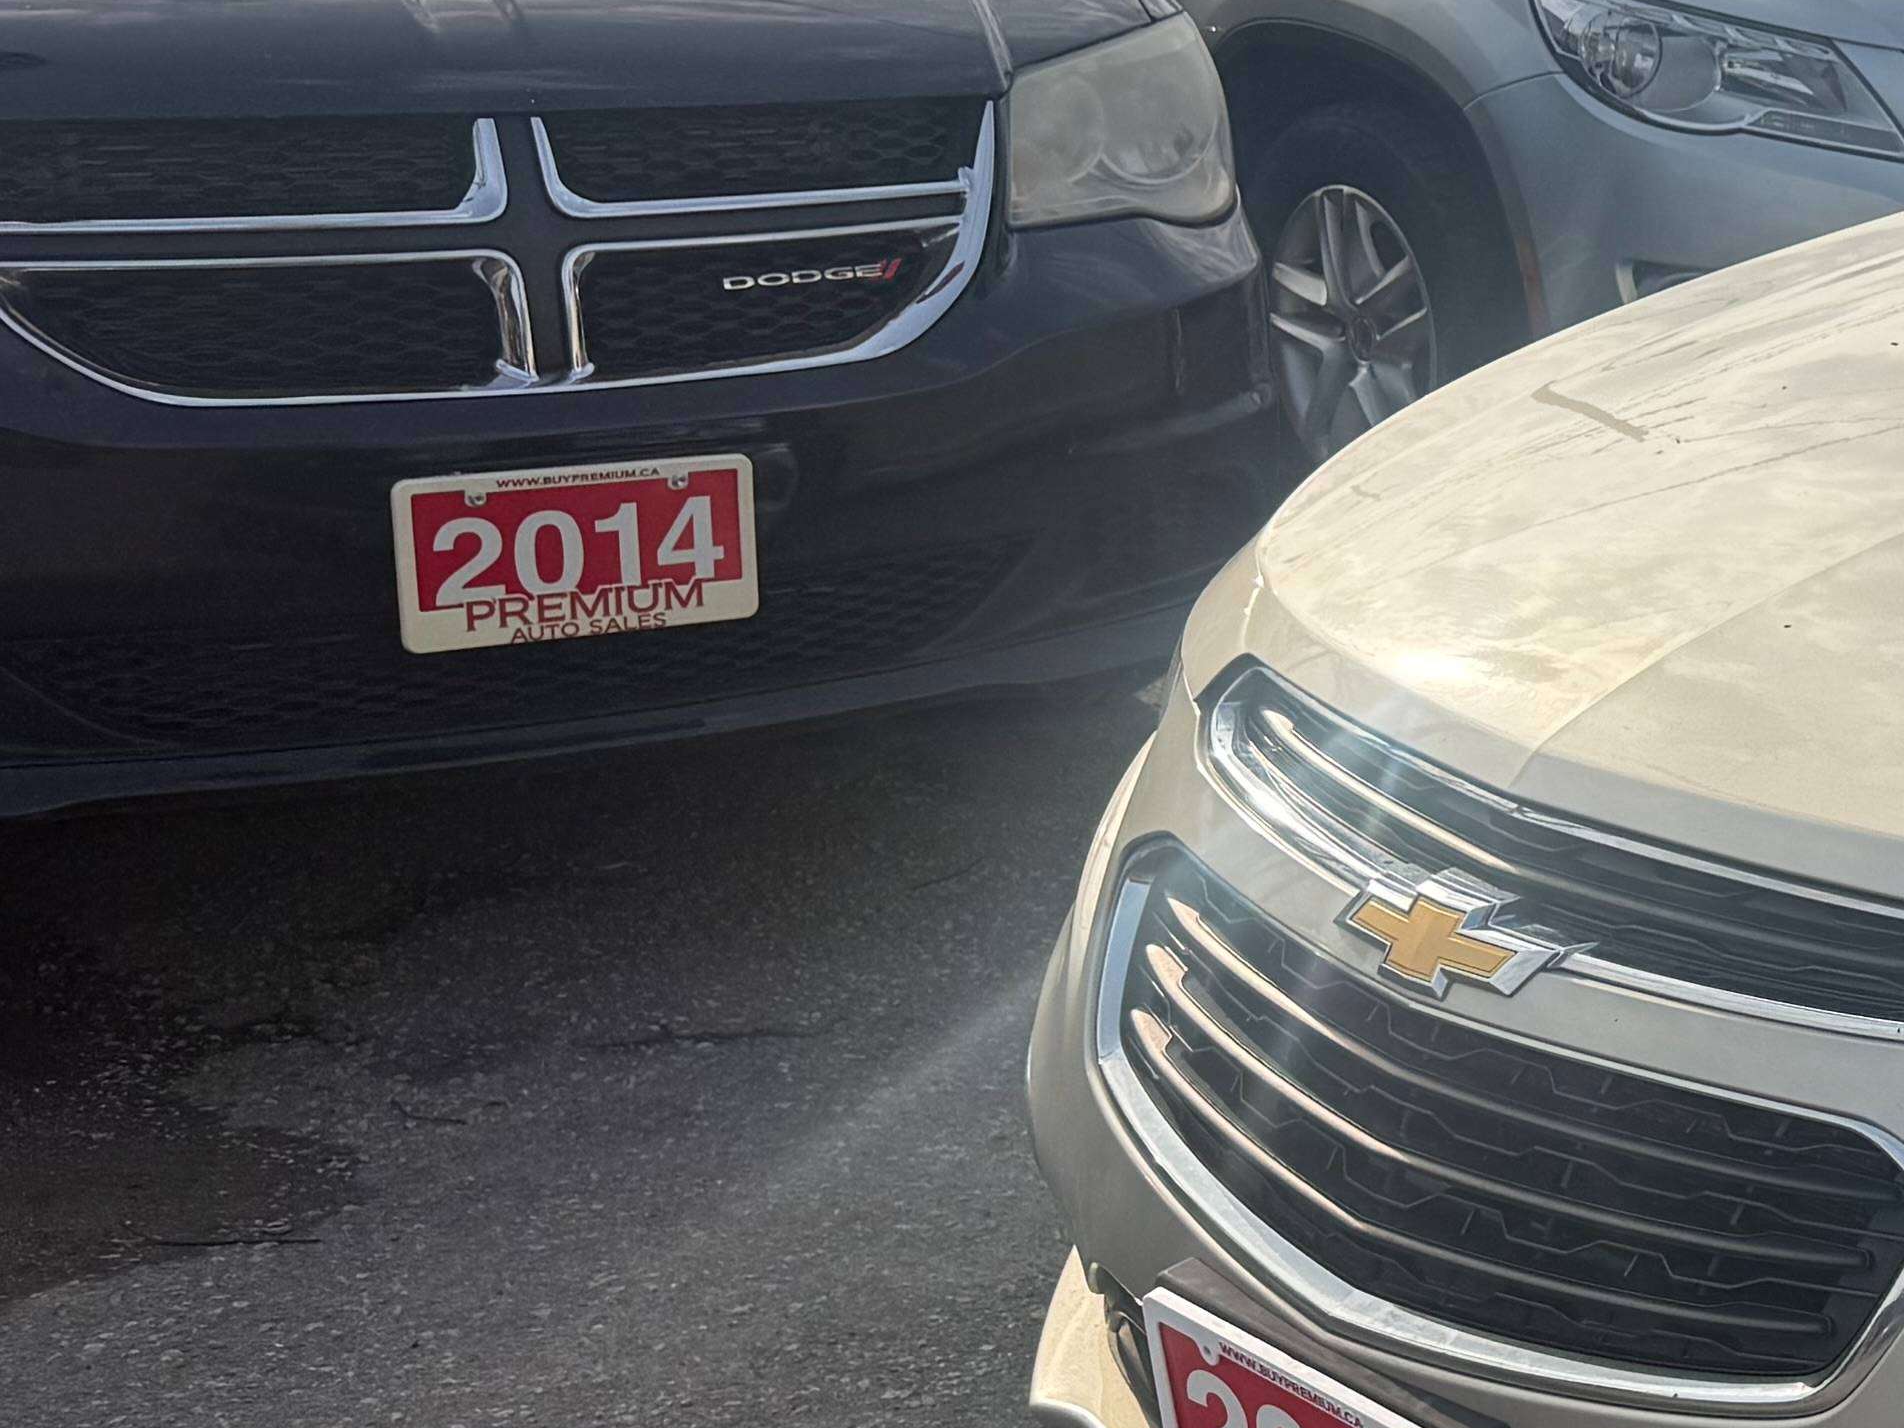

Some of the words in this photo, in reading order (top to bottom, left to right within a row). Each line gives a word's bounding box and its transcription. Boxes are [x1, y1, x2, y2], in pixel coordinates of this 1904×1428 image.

[723, 263, 884, 291] DODGE
[496, 467, 660, 489] WWW.BUYPREMIUM.CA
[432, 495, 725, 608] 2014
[465, 578, 704, 632] PREMIUM
[510, 622, 580, 644] AUTO
[590, 612, 667, 632] SALES
